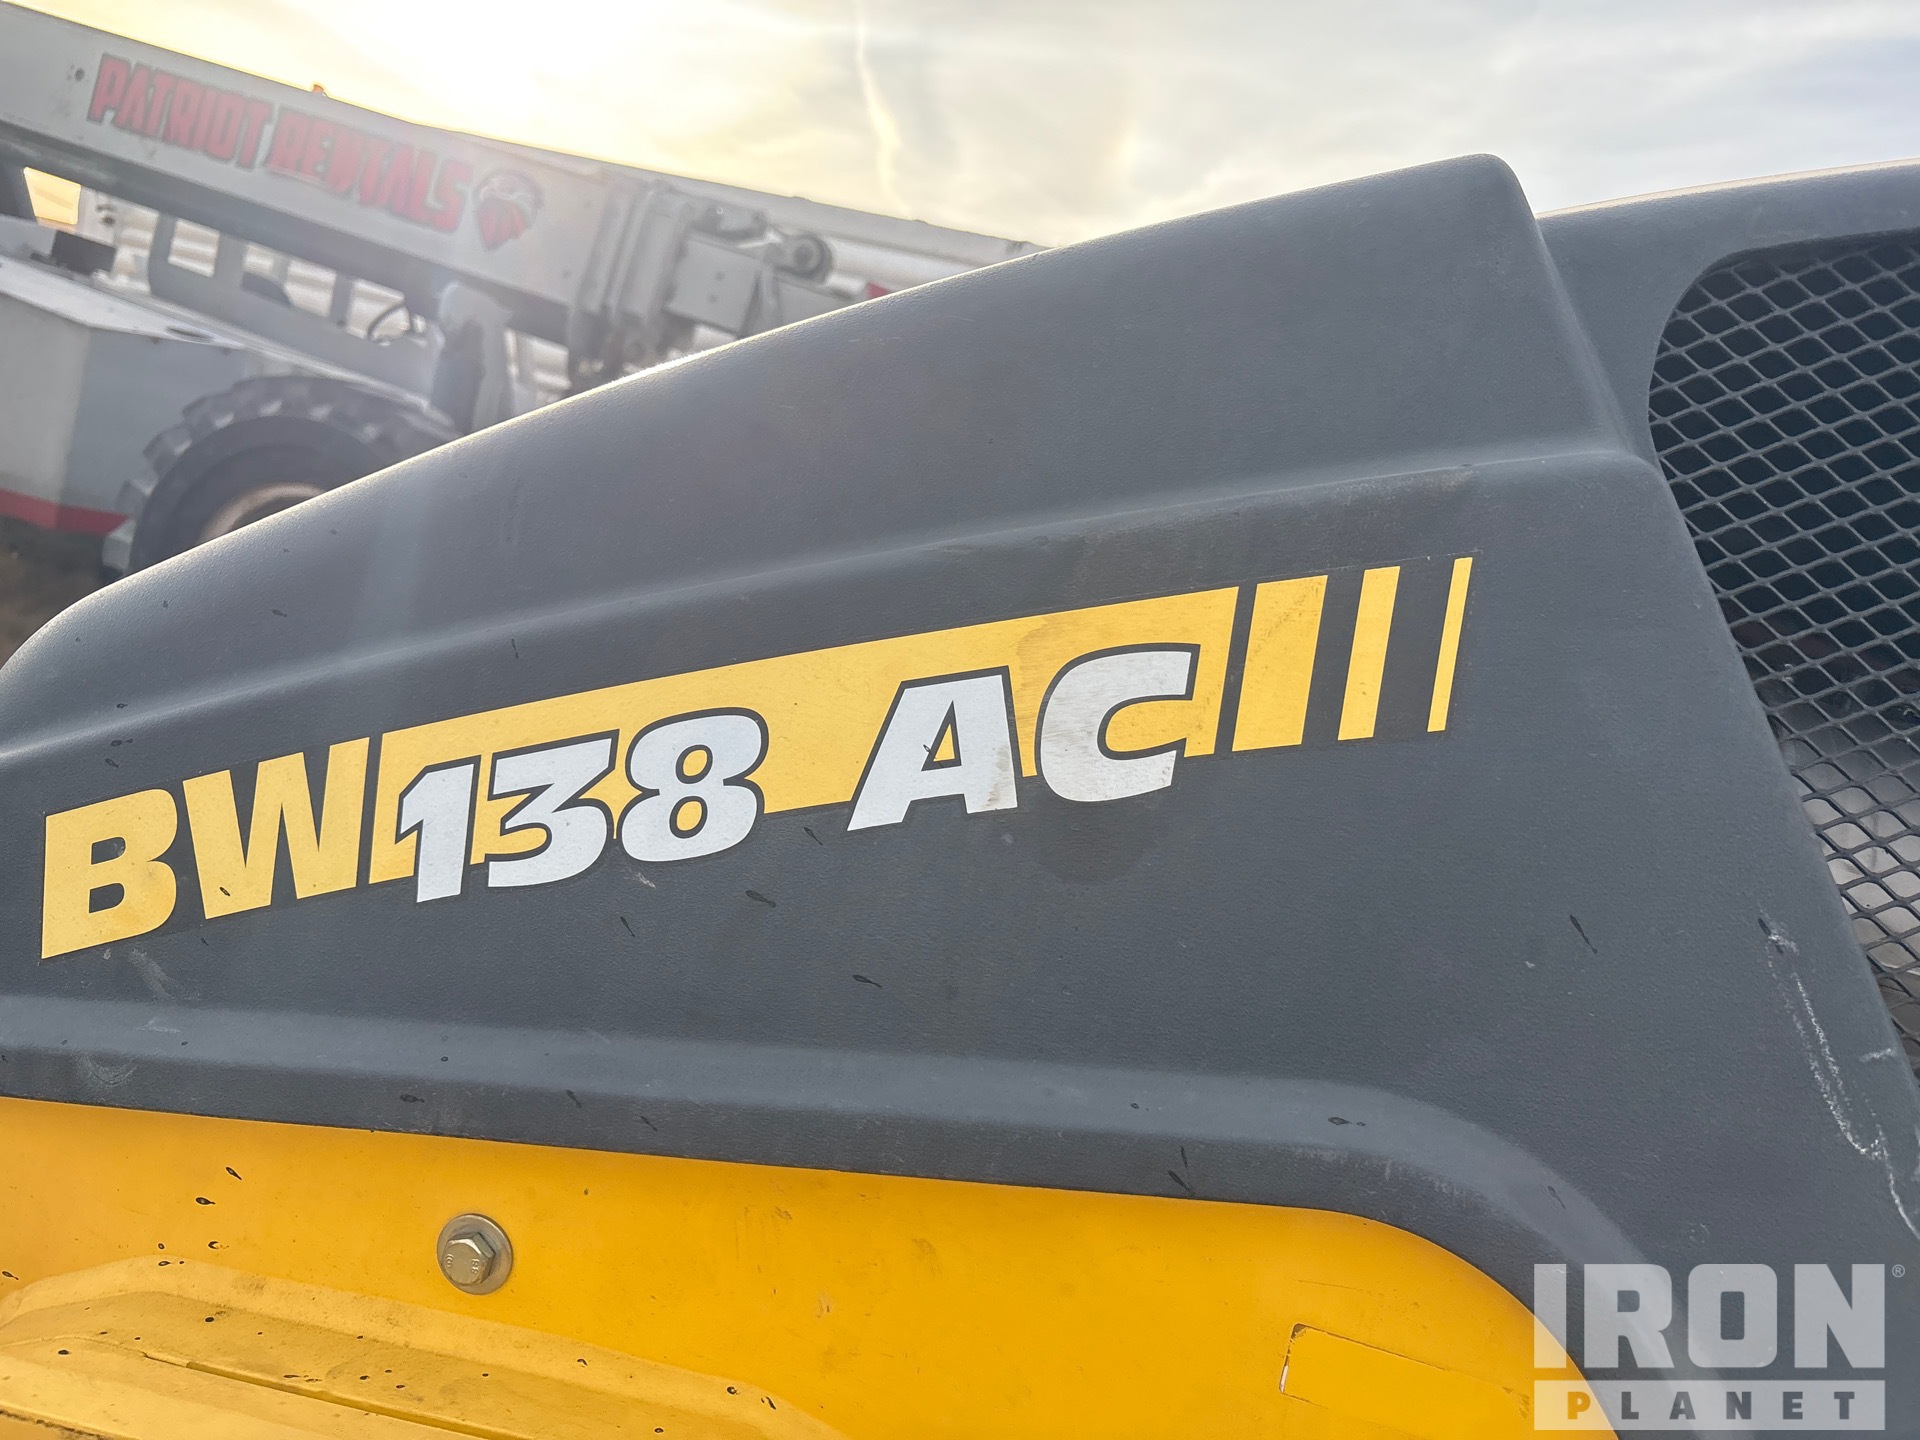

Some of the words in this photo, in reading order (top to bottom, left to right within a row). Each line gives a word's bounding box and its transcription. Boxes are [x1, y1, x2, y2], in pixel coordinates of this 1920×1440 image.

[87, 53, 273, 170] PATRIOT
[264, 107, 473, 234] RENTALS
[848, 651, 1192, 831] AC
